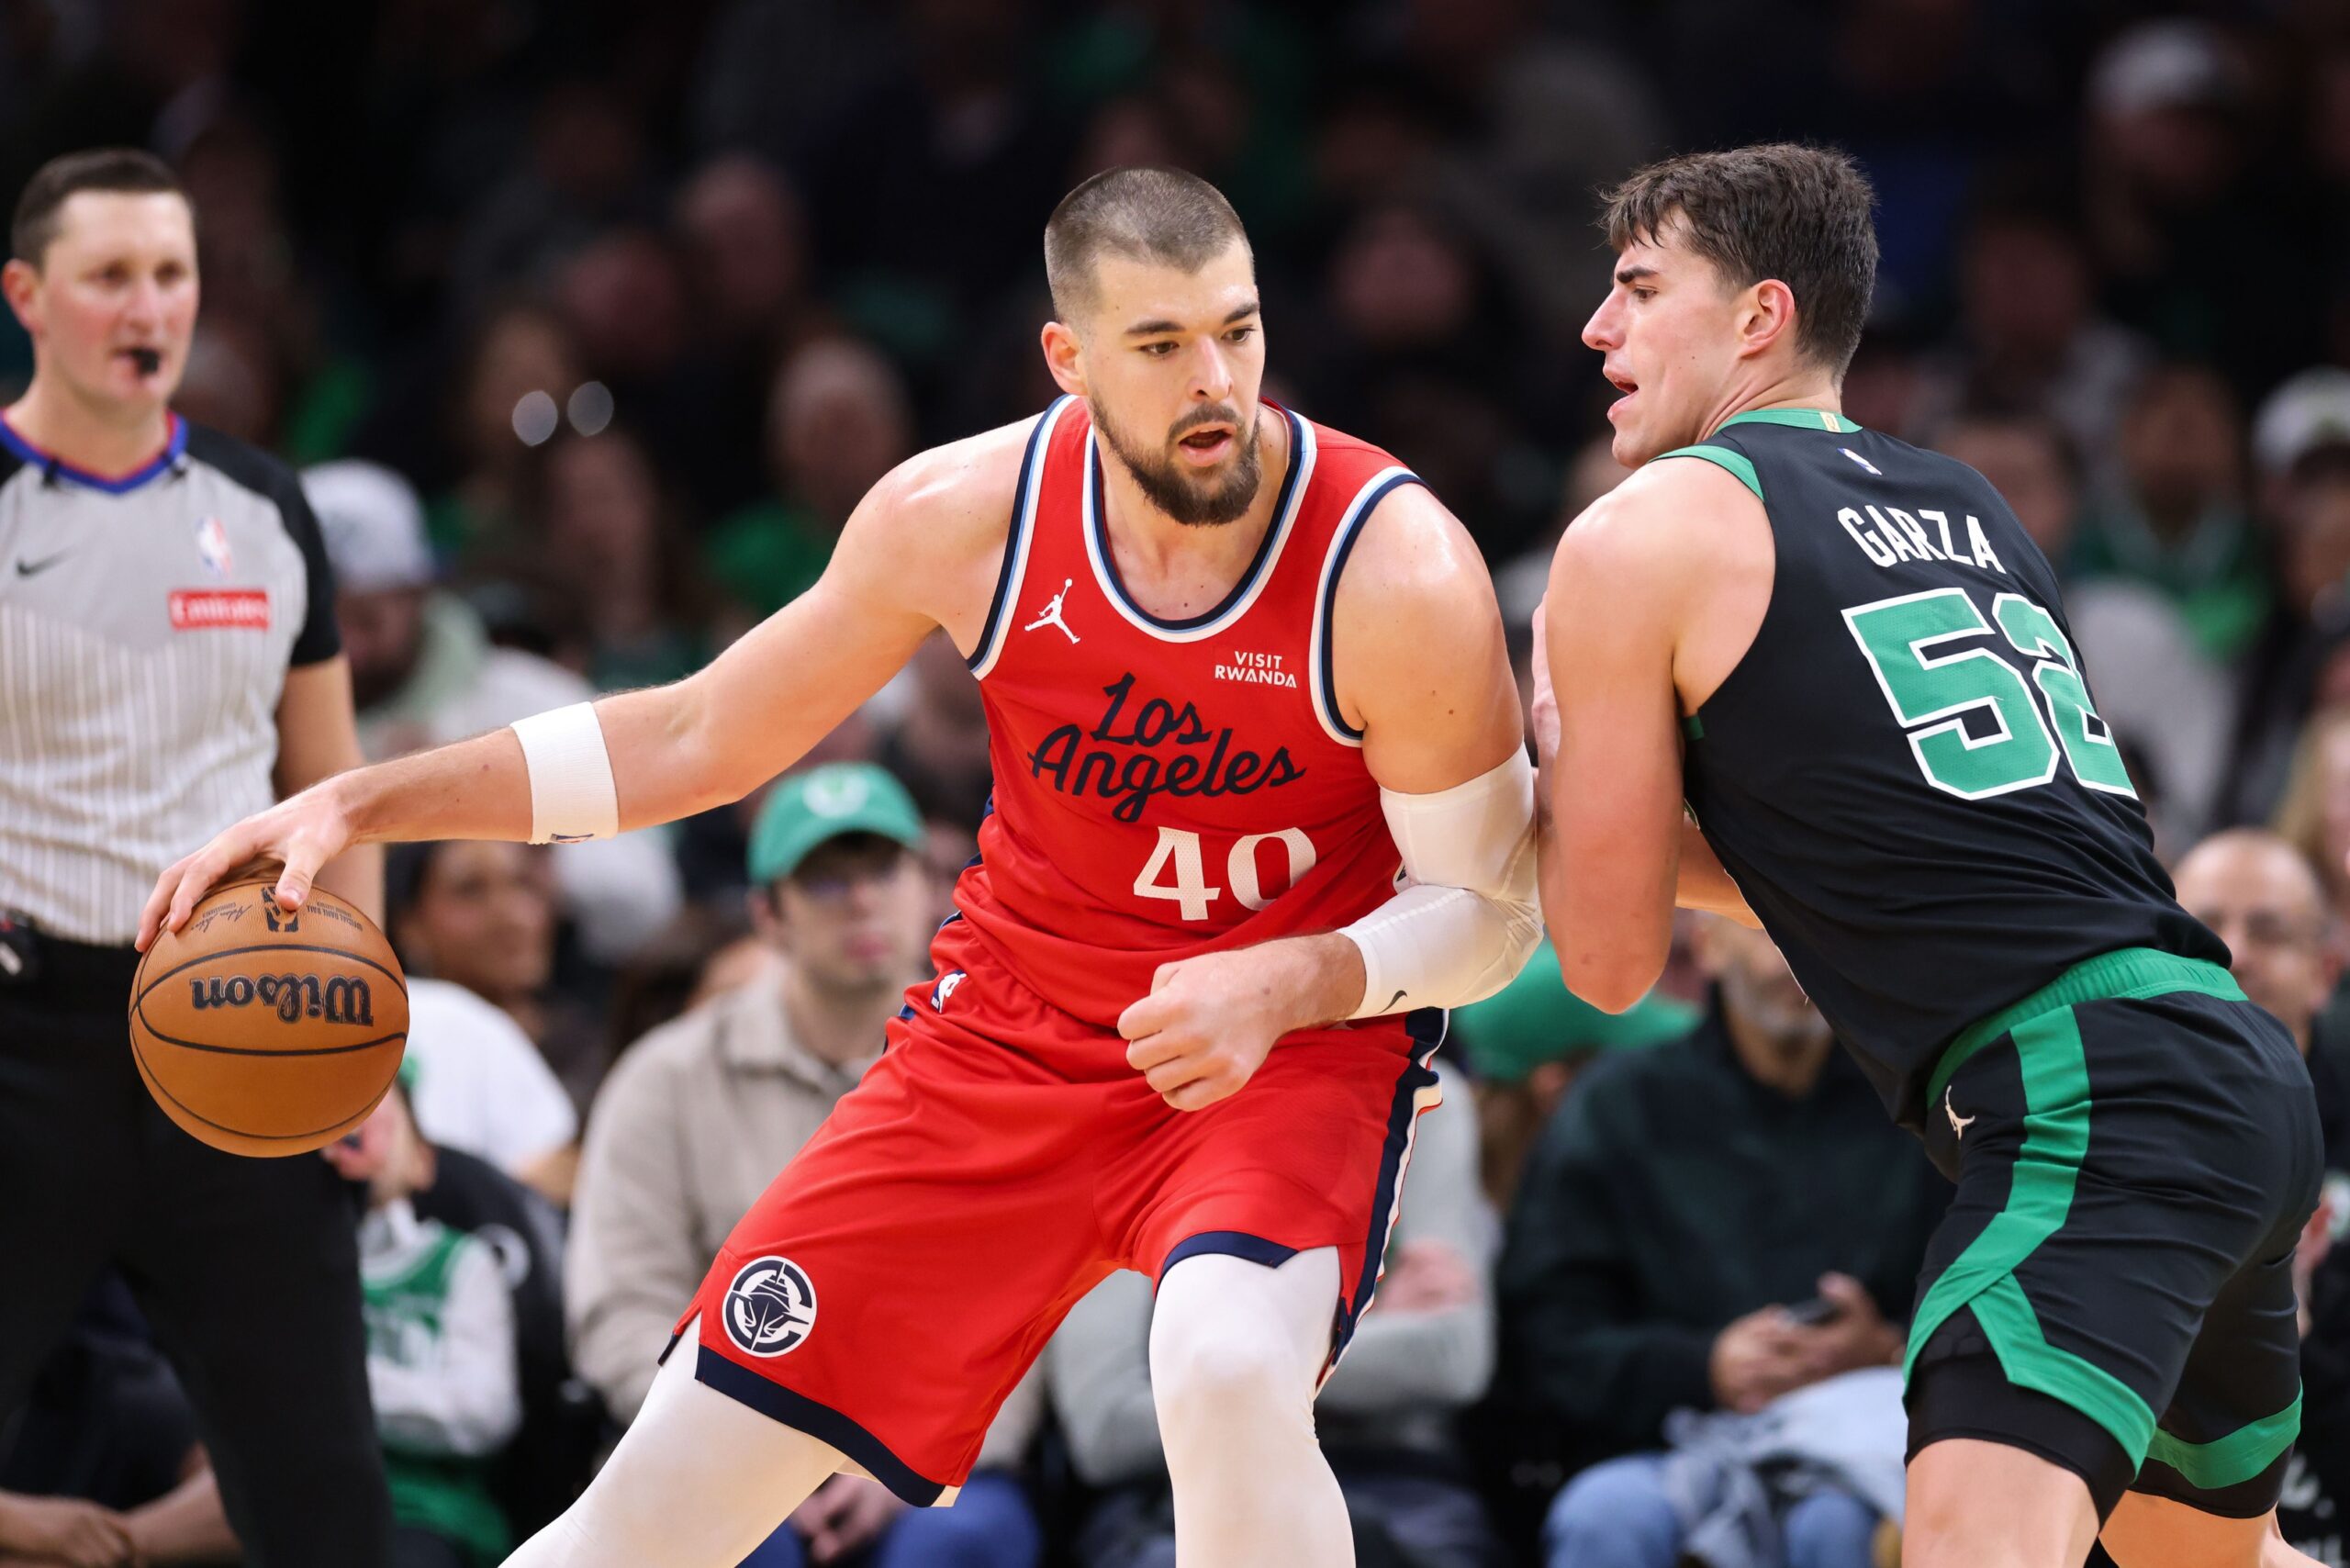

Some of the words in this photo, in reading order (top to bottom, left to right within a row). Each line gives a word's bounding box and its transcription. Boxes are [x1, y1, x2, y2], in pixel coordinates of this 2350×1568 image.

[1838, 505, 2007, 574] GARZA
[1214, 665, 1297, 689] RWANDA
[1235, 651, 1282, 669] VISIT
[1841, 588, 2140, 801] 52
[1090, 672, 1213, 747] Los
[1027, 723, 1307, 823] Angeles
[1133, 826, 1316, 921] 40
[190, 973, 375, 1026] Wilson
